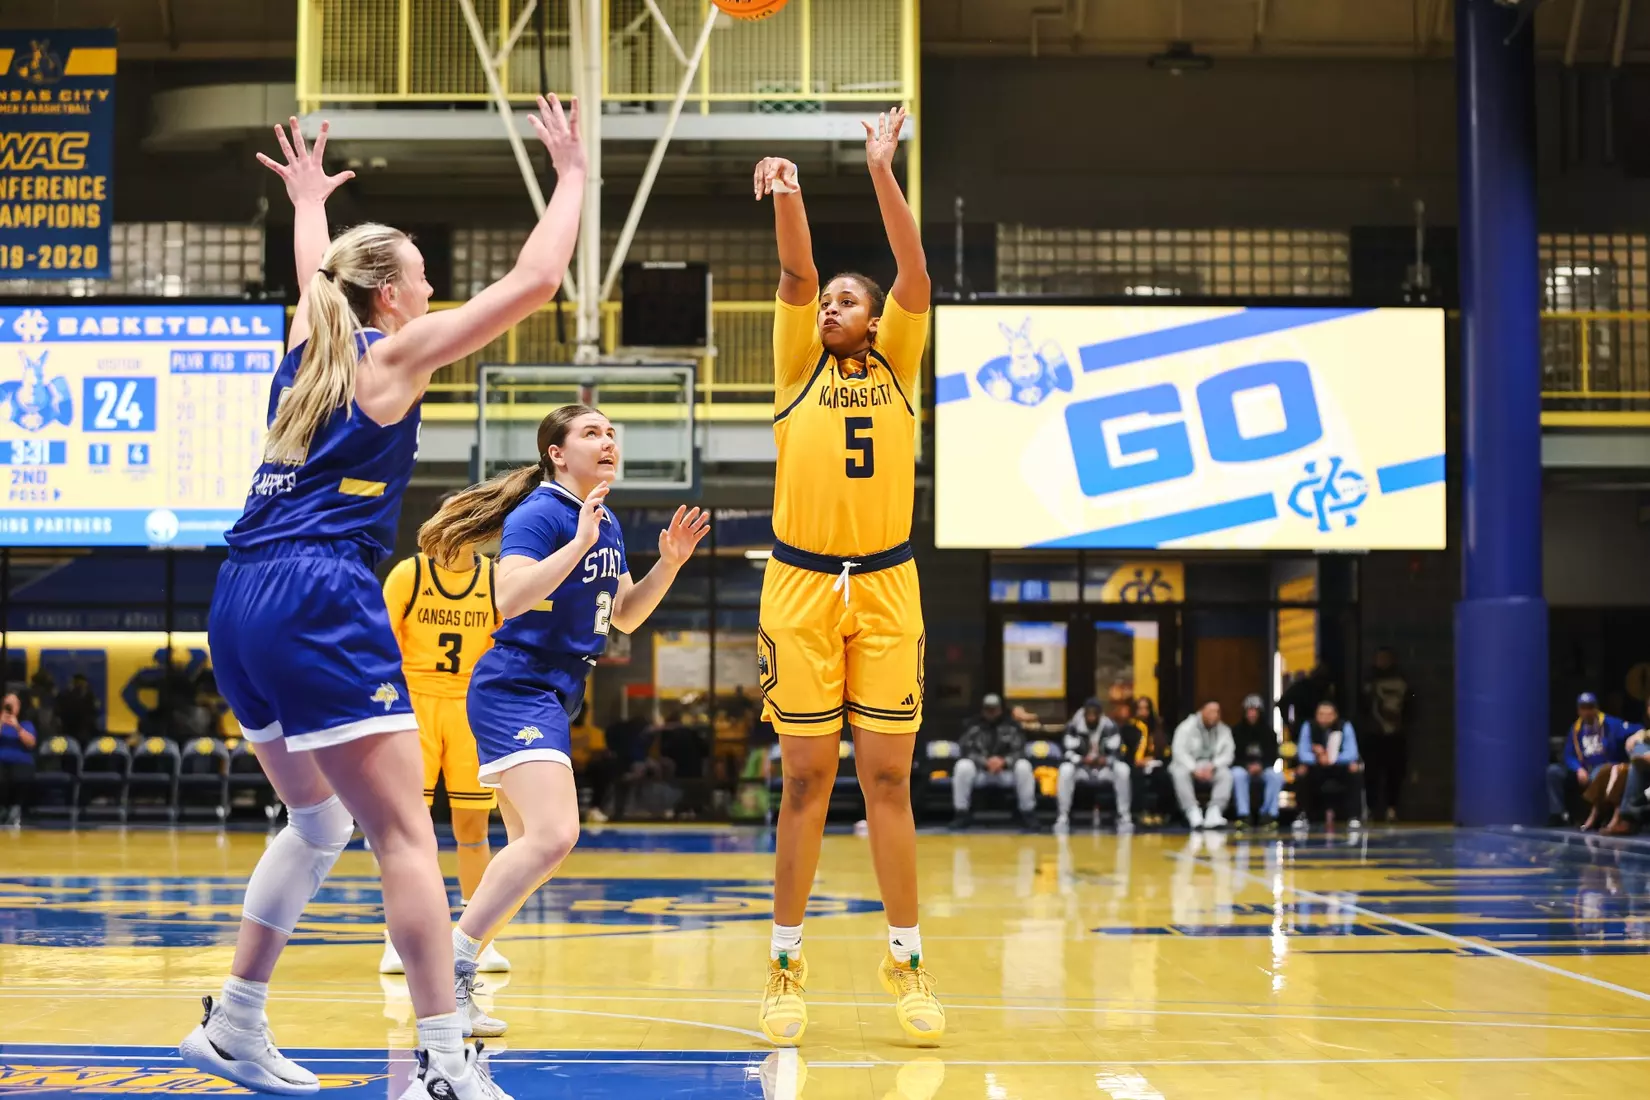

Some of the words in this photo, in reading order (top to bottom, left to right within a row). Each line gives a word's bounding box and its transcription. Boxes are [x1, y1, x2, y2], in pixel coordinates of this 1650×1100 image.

[59, 89, 109, 101] CITY
[0, 132, 90, 170] WAC
[0, 245, 98, 269] 19-2020
[57, 316, 271, 336] BASKETBALL
[94, 380, 143, 429] 24
[1064, 360, 1324, 497] GO
[845, 417, 874, 478] 5
[12, 470, 47, 484] 2ND
[34, 517, 112, 533] PARTNERS
[417, 608, 461, 627] KANSAS
[464, 611, 489, 627] CITY
[436, 633, 463, 674] 3
